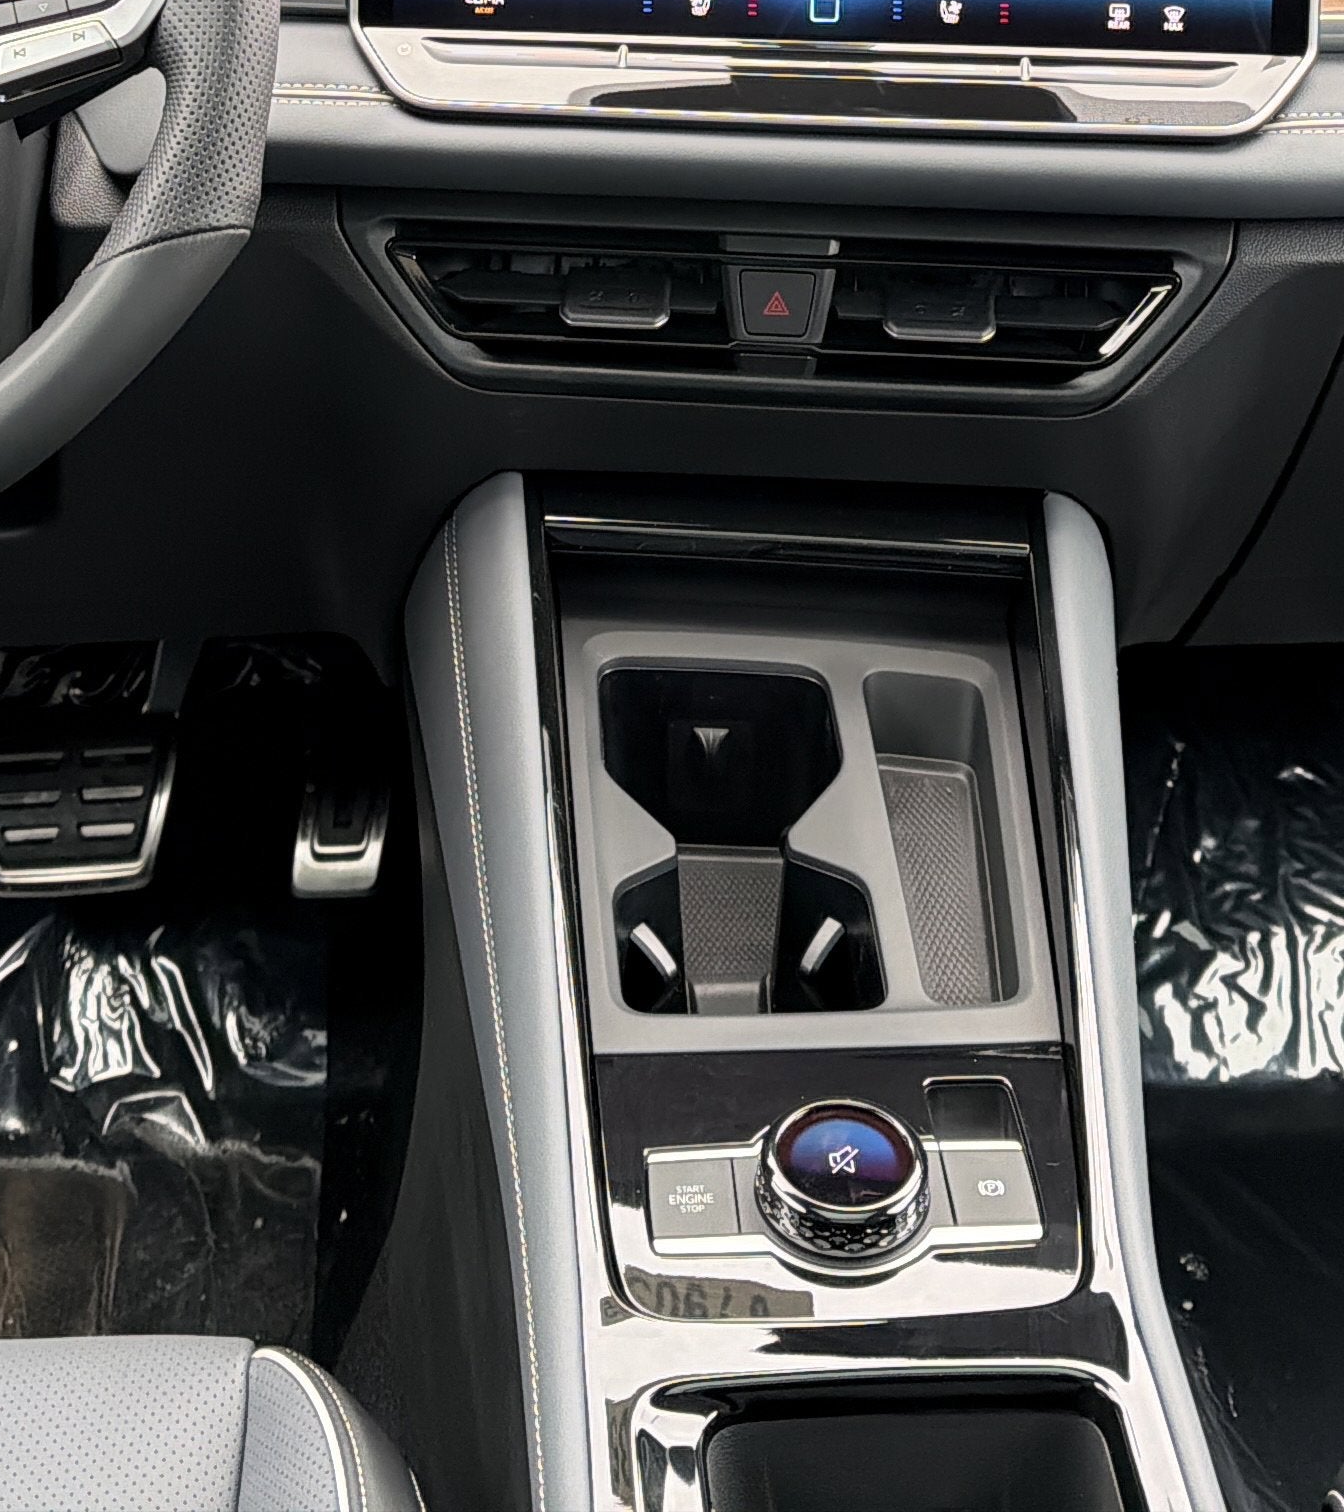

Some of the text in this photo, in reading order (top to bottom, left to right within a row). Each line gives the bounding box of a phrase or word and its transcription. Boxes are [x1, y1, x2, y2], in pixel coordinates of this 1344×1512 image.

[1107, 20, 1131, 31] REAR
[675, 1185, 706, 1194] START
[668, 1192, 715, 1206] ENGINE
[680, 1203, 706, 1213] STOP
